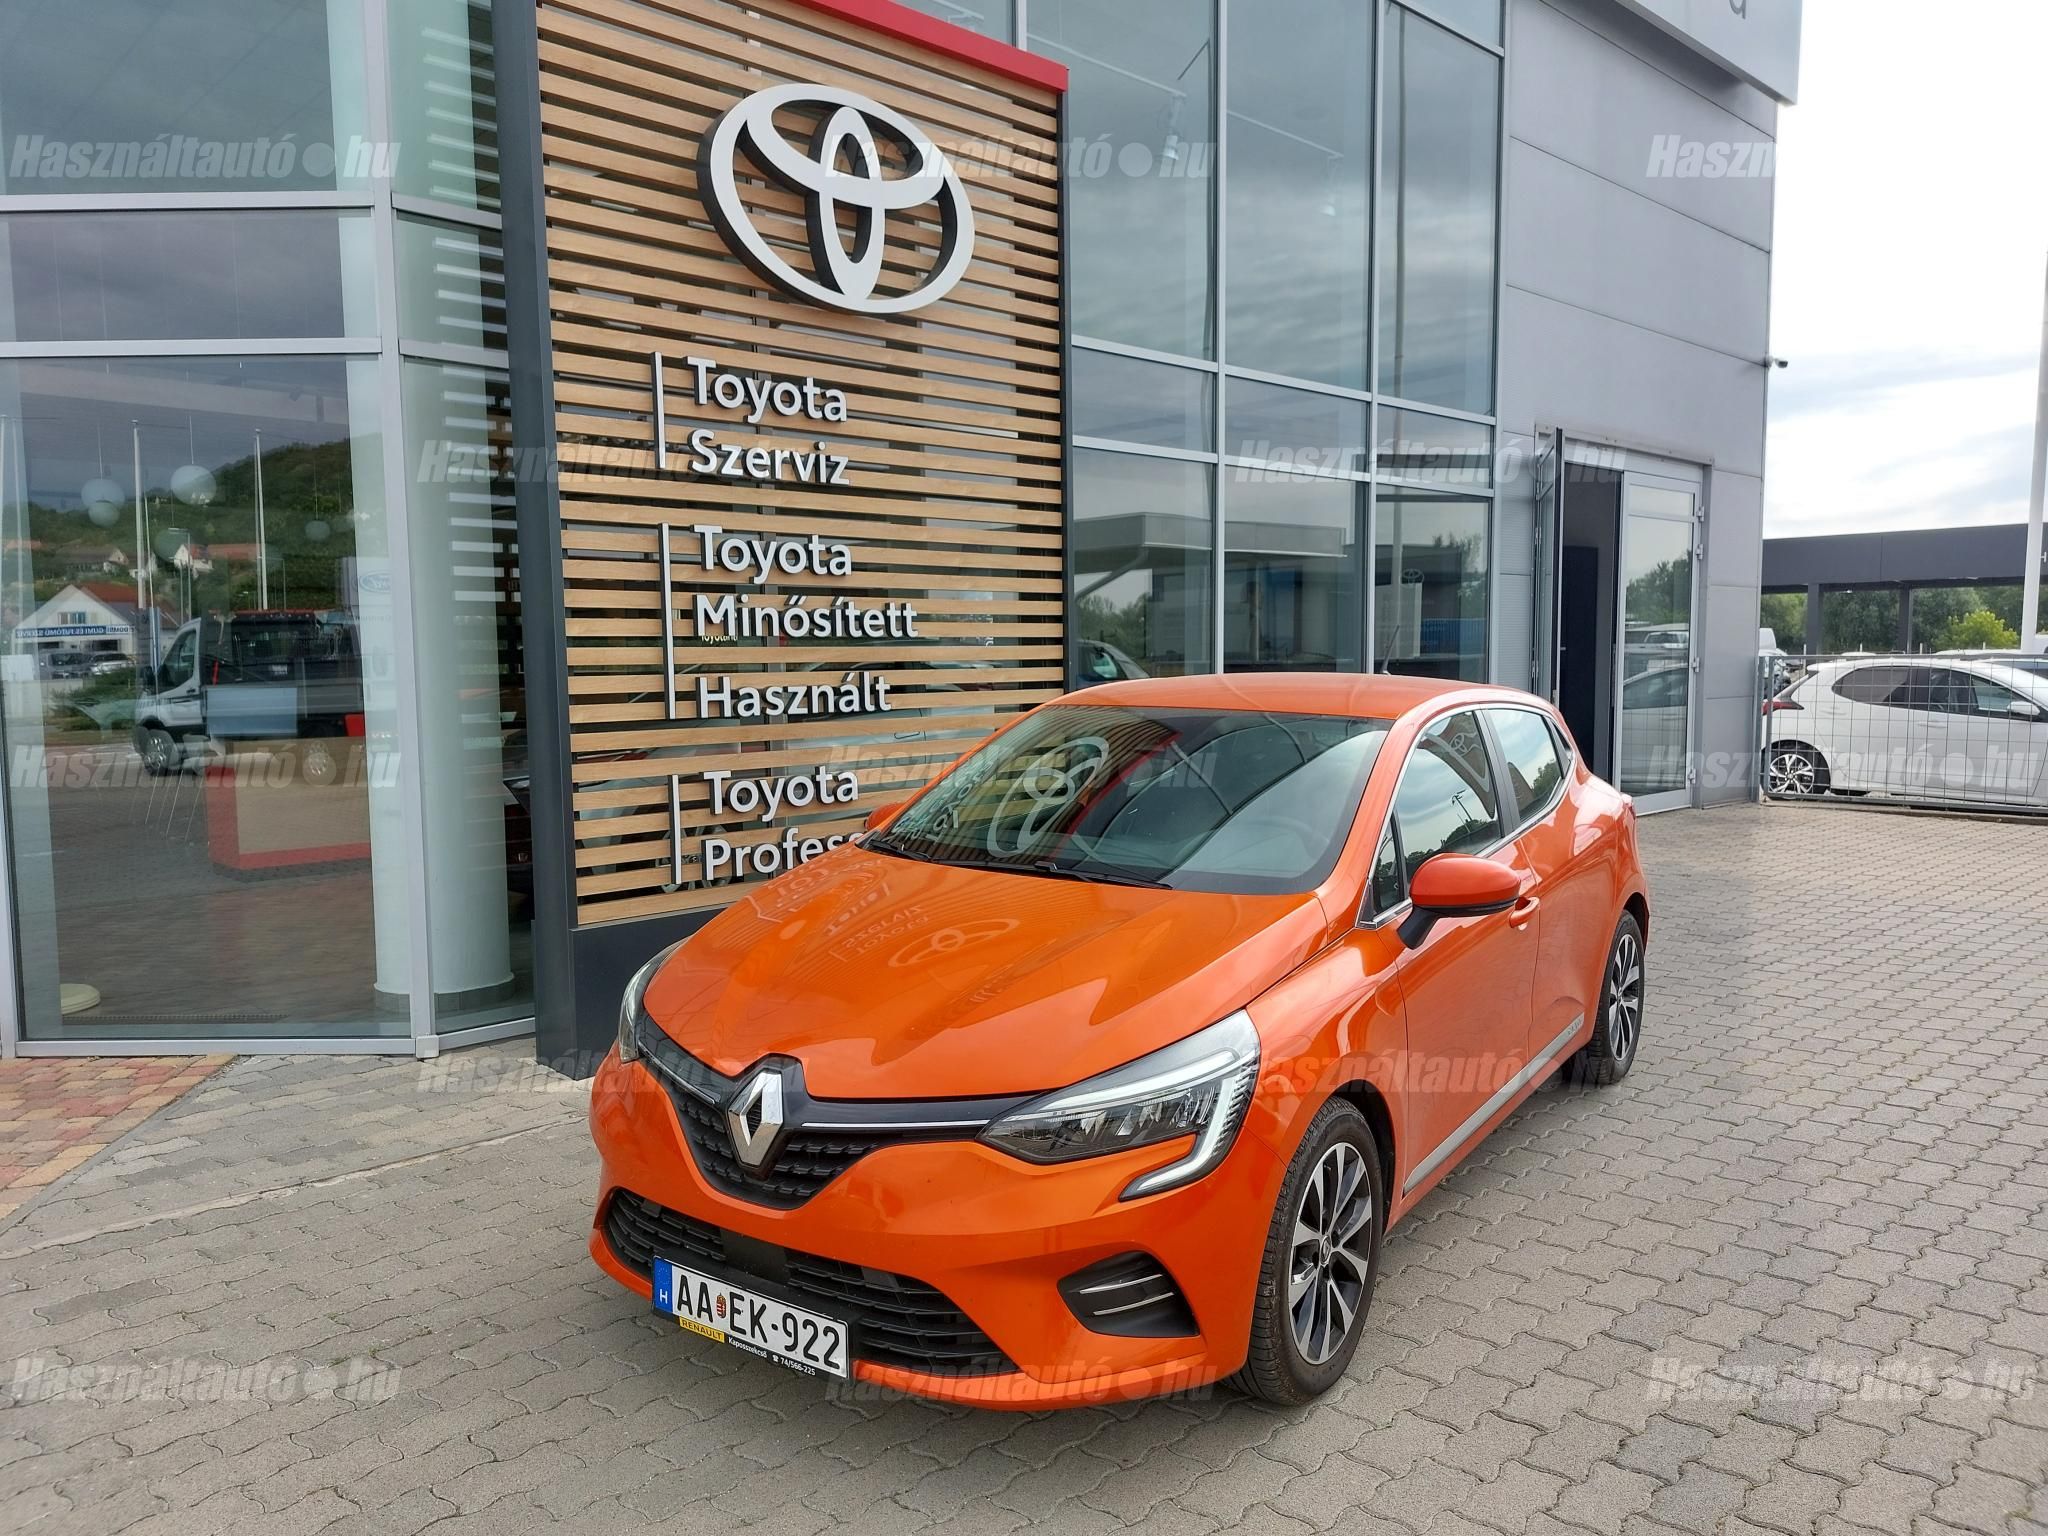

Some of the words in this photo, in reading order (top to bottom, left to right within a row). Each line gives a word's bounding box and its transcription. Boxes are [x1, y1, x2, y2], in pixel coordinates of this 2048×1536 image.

[687, 356, 847, 424] Toyota
[691, 429, 849, 485] Szerviz
[694, 524, 852, 584] Toyota
[696, 594, 918, 638] Minősített
[700, 671, 892, 719] Használt
[704, 765, 858, 822] Toyota
[660, 1288, 669, 1305] H
[677, 1274, 714, 1324] AA
[729, 1291, 841, 1370] EK-922
[681, 1319, 724, 1341] RENAULT
